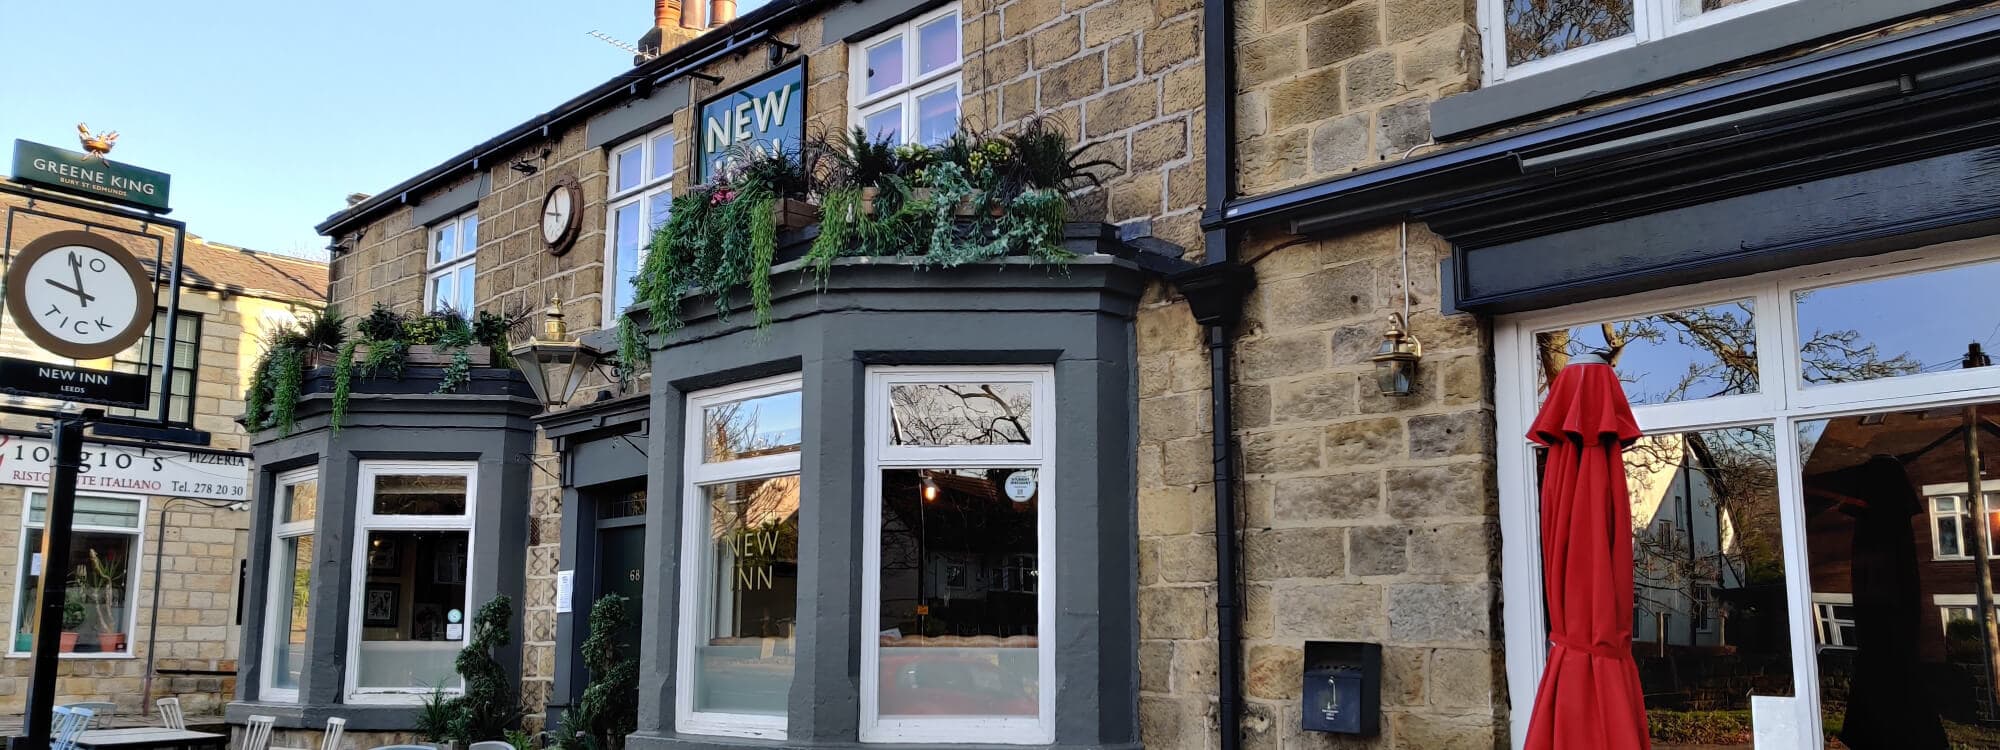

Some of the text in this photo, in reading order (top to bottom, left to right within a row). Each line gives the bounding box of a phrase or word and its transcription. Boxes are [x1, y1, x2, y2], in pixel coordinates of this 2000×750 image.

[707, 84, 791, 153] NEW
[33, 158, 155, 195] GREENE KING
[60, 177, 78, 186] BURY
[92, 184, 127, 197] EDMUNDS
[68, 254, 106, 273] NO
[45, 304, 113, 335] TICK
[39, 367, 108, 386] NEW INN
[60, 385, 85, 394] LEEDS
[188, 451, 245, 467] PIZZERIA
[100, 476, 161, 491] ITALIANO
[172, 480, 244, 496] Tel. 278 20 30
[726, 530, 779, 558] NEW
[629, 569, 641, 581] 68
[730, 565, 773, 591] INN
